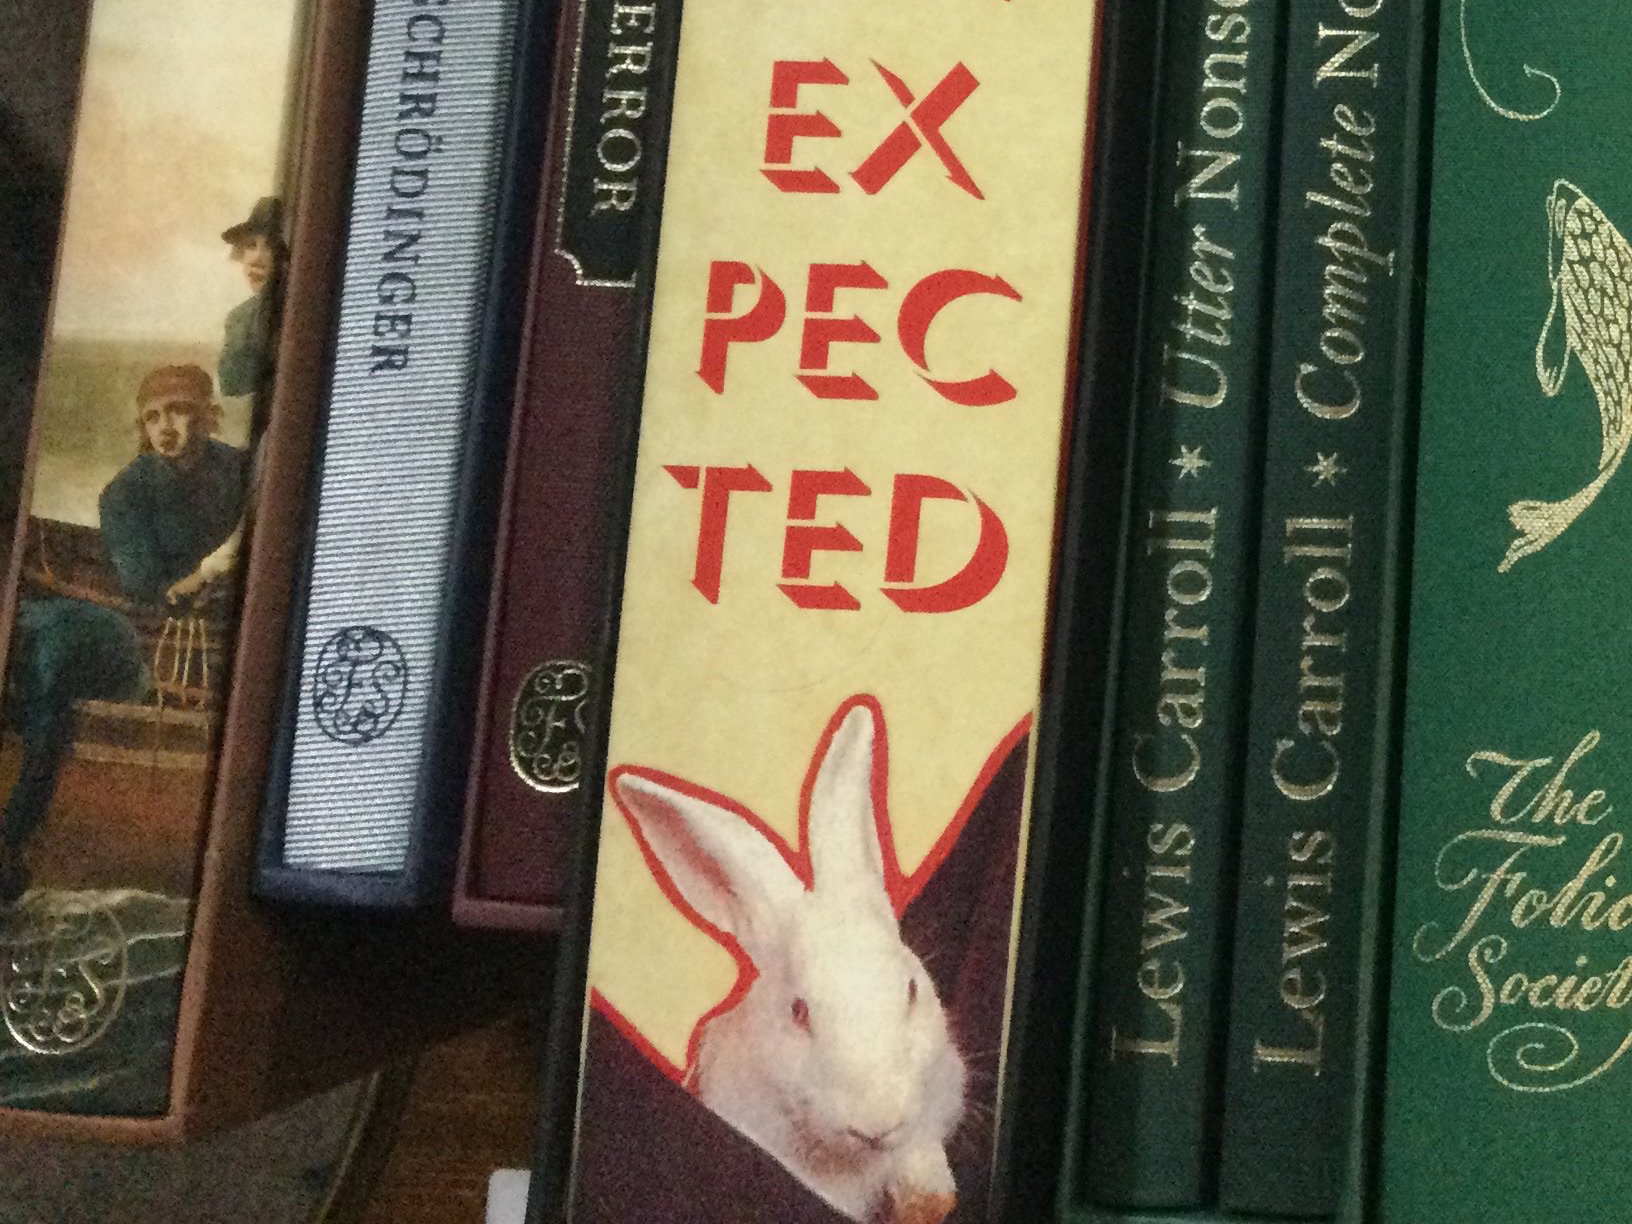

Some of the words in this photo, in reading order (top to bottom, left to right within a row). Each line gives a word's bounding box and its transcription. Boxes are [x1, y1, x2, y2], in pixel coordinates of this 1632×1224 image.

[758, 56, 986, 203] EX
[694, 259, 1024, 408] PEC
[1158, 223, 1236, 410] Utter
[1294, 102, 1397, 422] Complete
[661, 463, 1010, 615] TED
[1132, 506, 1220, 794] Carroll
[1272, 512, 1355, 803] Carroll
[1465, 728, 1614, 826] The
[1110, 821, 1196, 1068] Lewis
[1252, 829, 1334, 1078] Lewis
